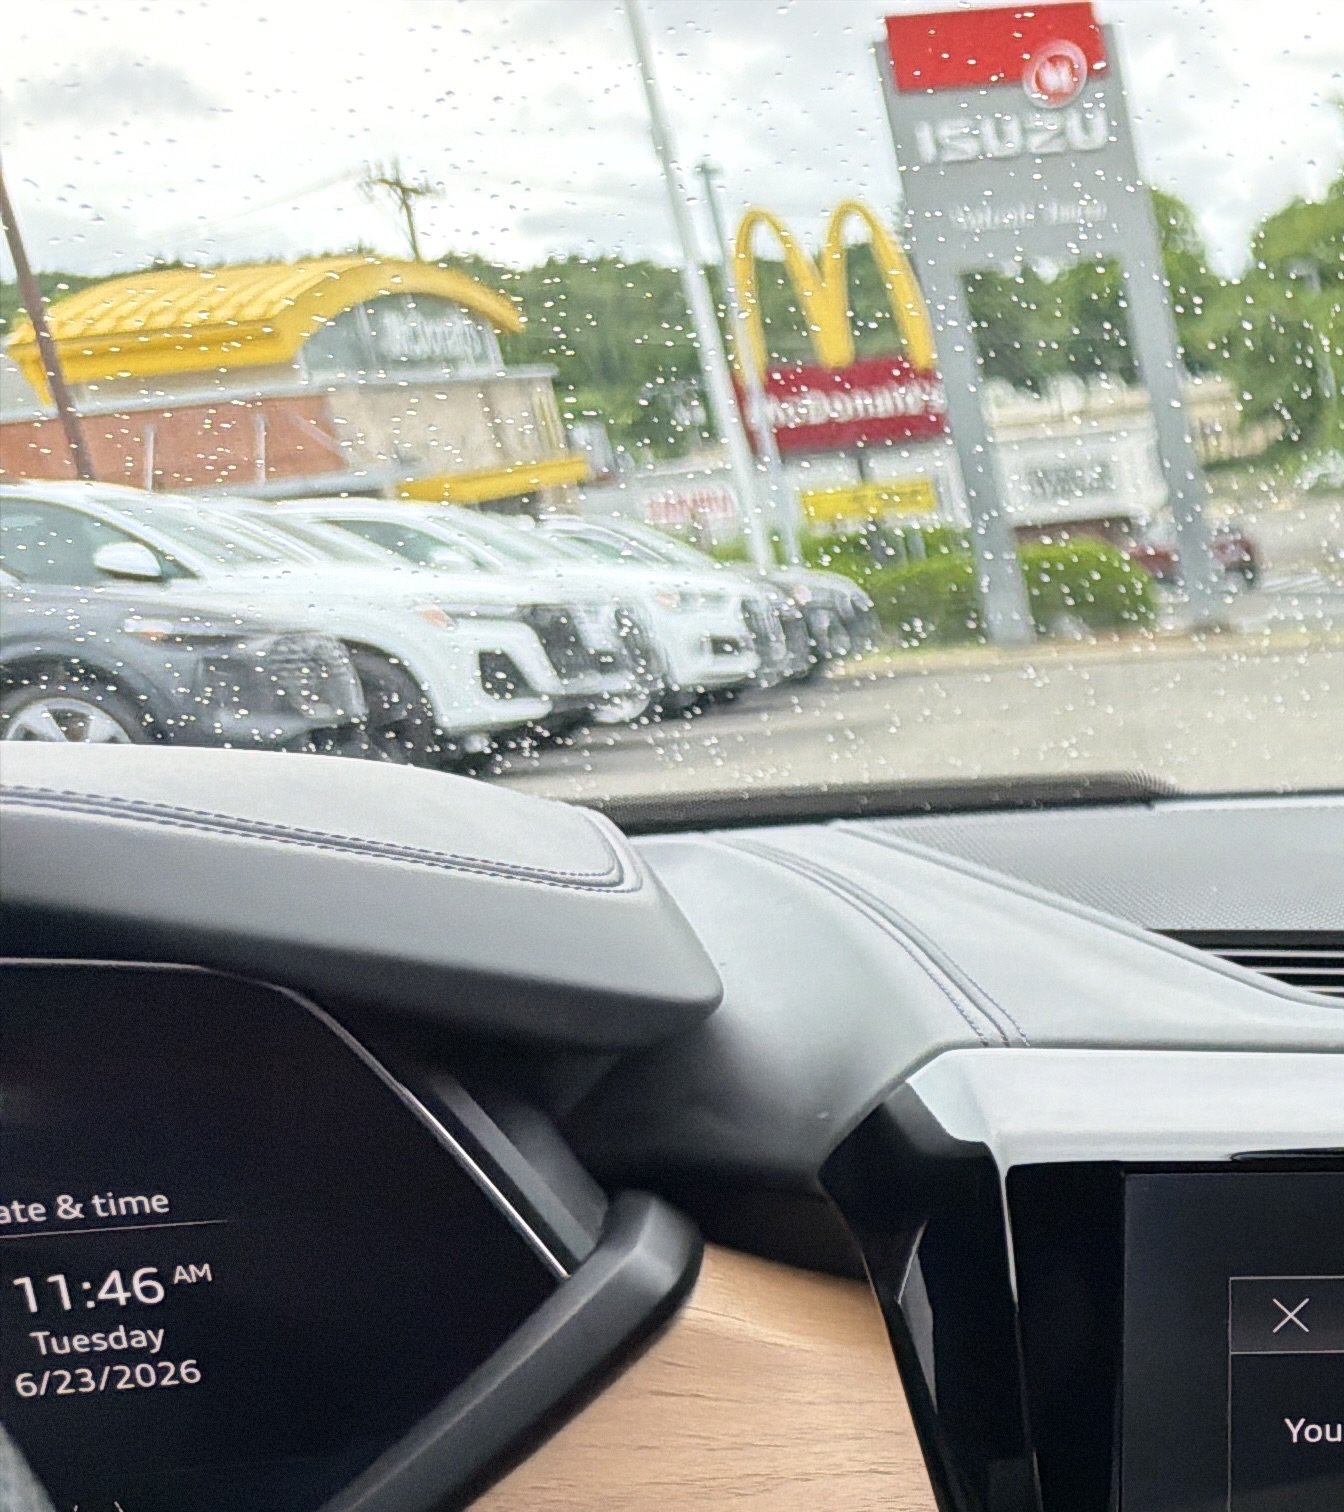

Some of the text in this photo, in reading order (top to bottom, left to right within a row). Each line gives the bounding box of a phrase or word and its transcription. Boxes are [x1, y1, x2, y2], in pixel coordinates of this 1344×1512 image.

[915, 109, 1107, 163] ISUZU
[57, 1195, 84, 1219] &
[92, 1192, 169, 1217] time
[13, 1263, 212, 1312] 11:46 AM
[30, 1325, 164, 1355] Tuesday
[15, 1360, 201, 1397] 6/23/2026
